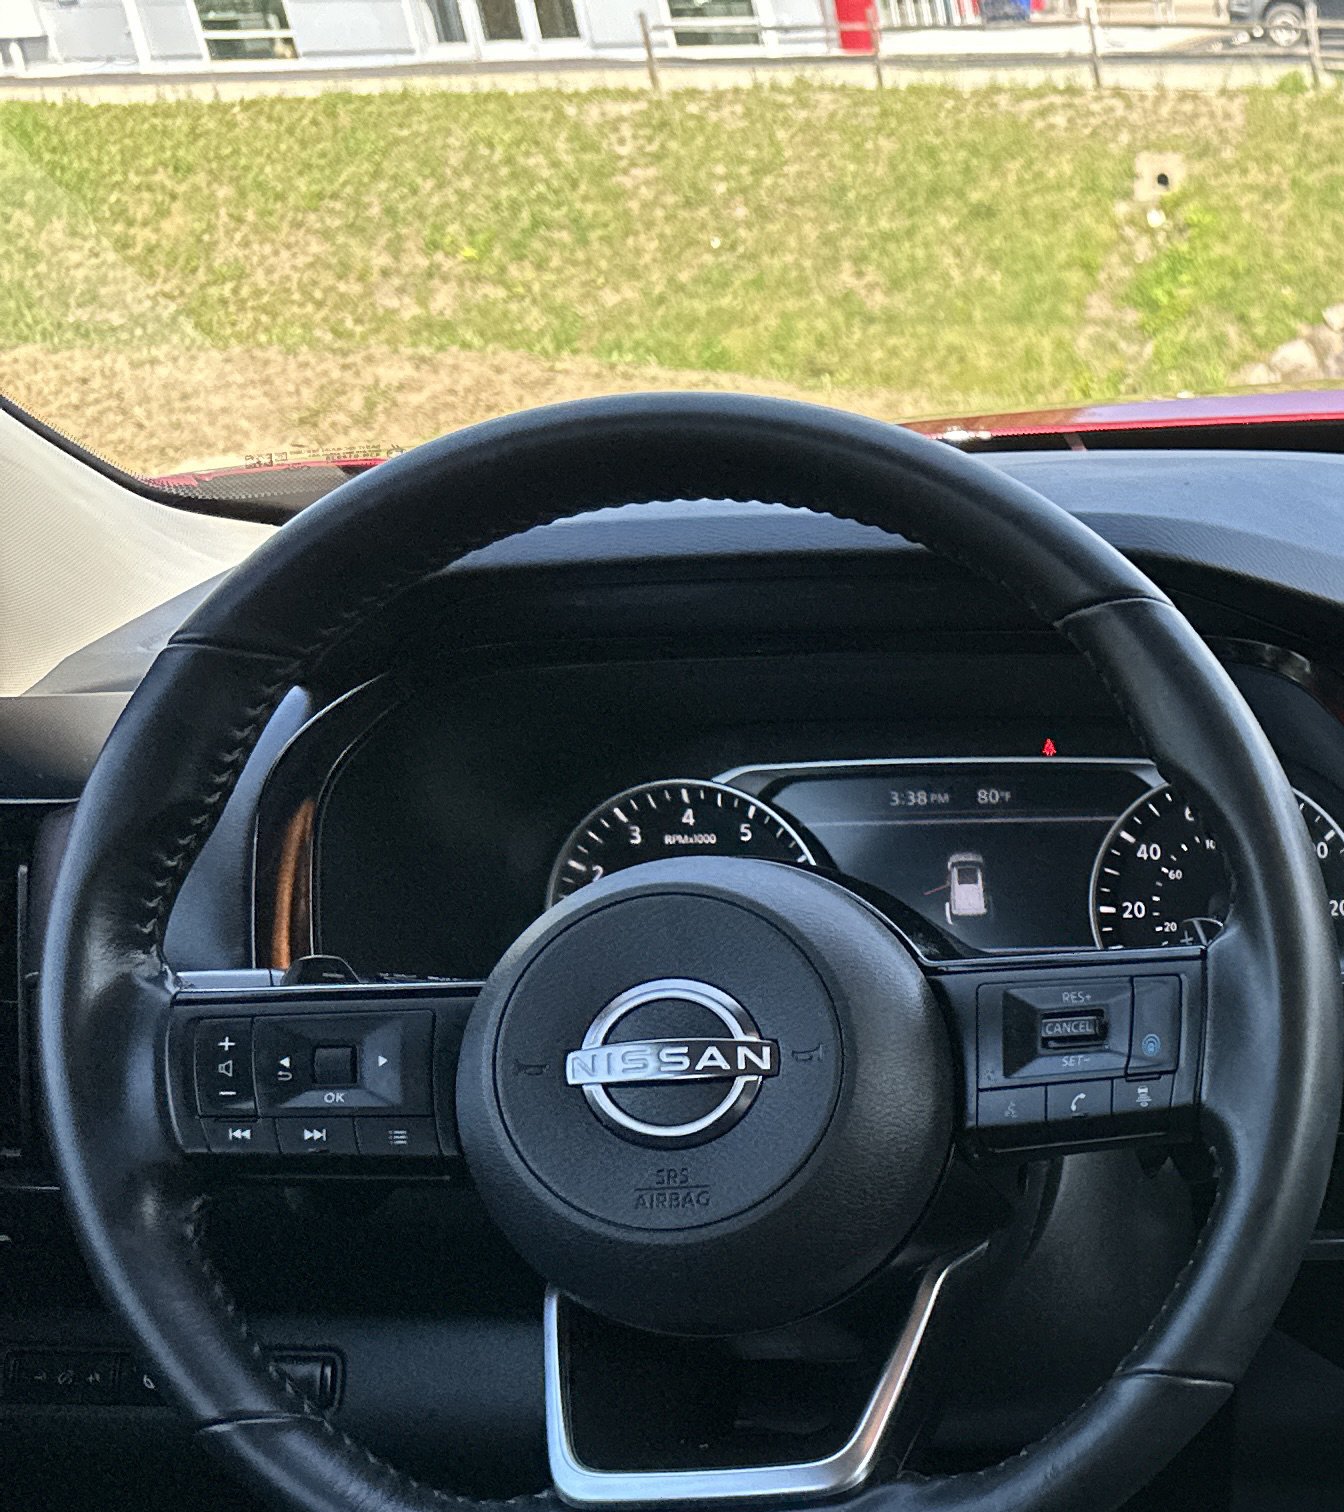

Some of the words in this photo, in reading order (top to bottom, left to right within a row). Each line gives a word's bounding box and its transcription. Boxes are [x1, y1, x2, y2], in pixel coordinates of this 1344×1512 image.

[890, 790, 928, 806] 3:38
[930, 793, 950, 804] PM
[682, 808, 695, 826] 4
[629, 826, 642, 845] 3
[740, 823, 752, 842] 5
[1136, 843, 1161, 860] 40
[1168, 869, 1182, 880] 60
[1122, 901, 1146, 918] 20
[1164, 921, 1177, 932] 20
[1045, 1021, 1092, 1035] CANCEL
[571, 1046, 771, 1079] NISSAN
[323, 1092, 345, 1103] OK
[656, 1168, 689, 1184] SRS
[635, 1190, 710, 1209] AIRBAG
